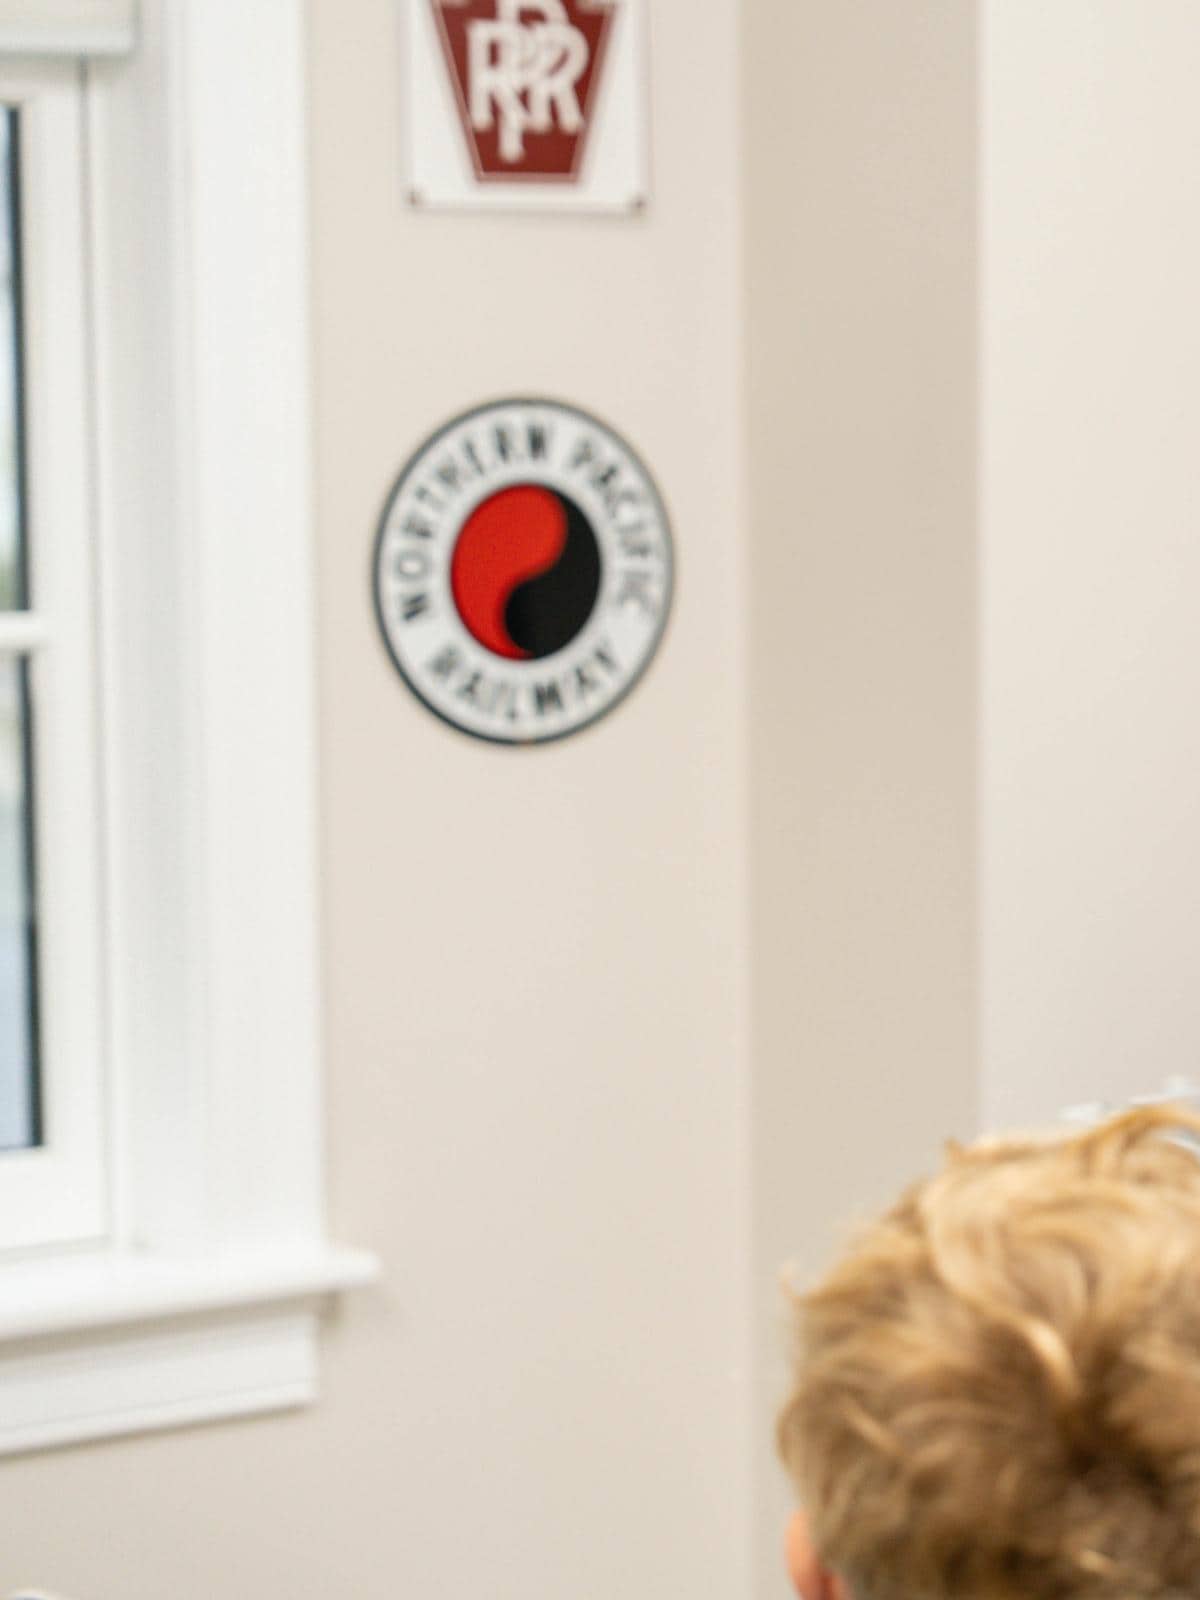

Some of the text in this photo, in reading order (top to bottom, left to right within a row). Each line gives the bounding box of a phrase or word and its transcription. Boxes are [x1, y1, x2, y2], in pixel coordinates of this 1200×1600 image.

[393, 422, 655, 622] NORTHERN PACIFIC
[426, 644, 617, 720] RAILWAY
